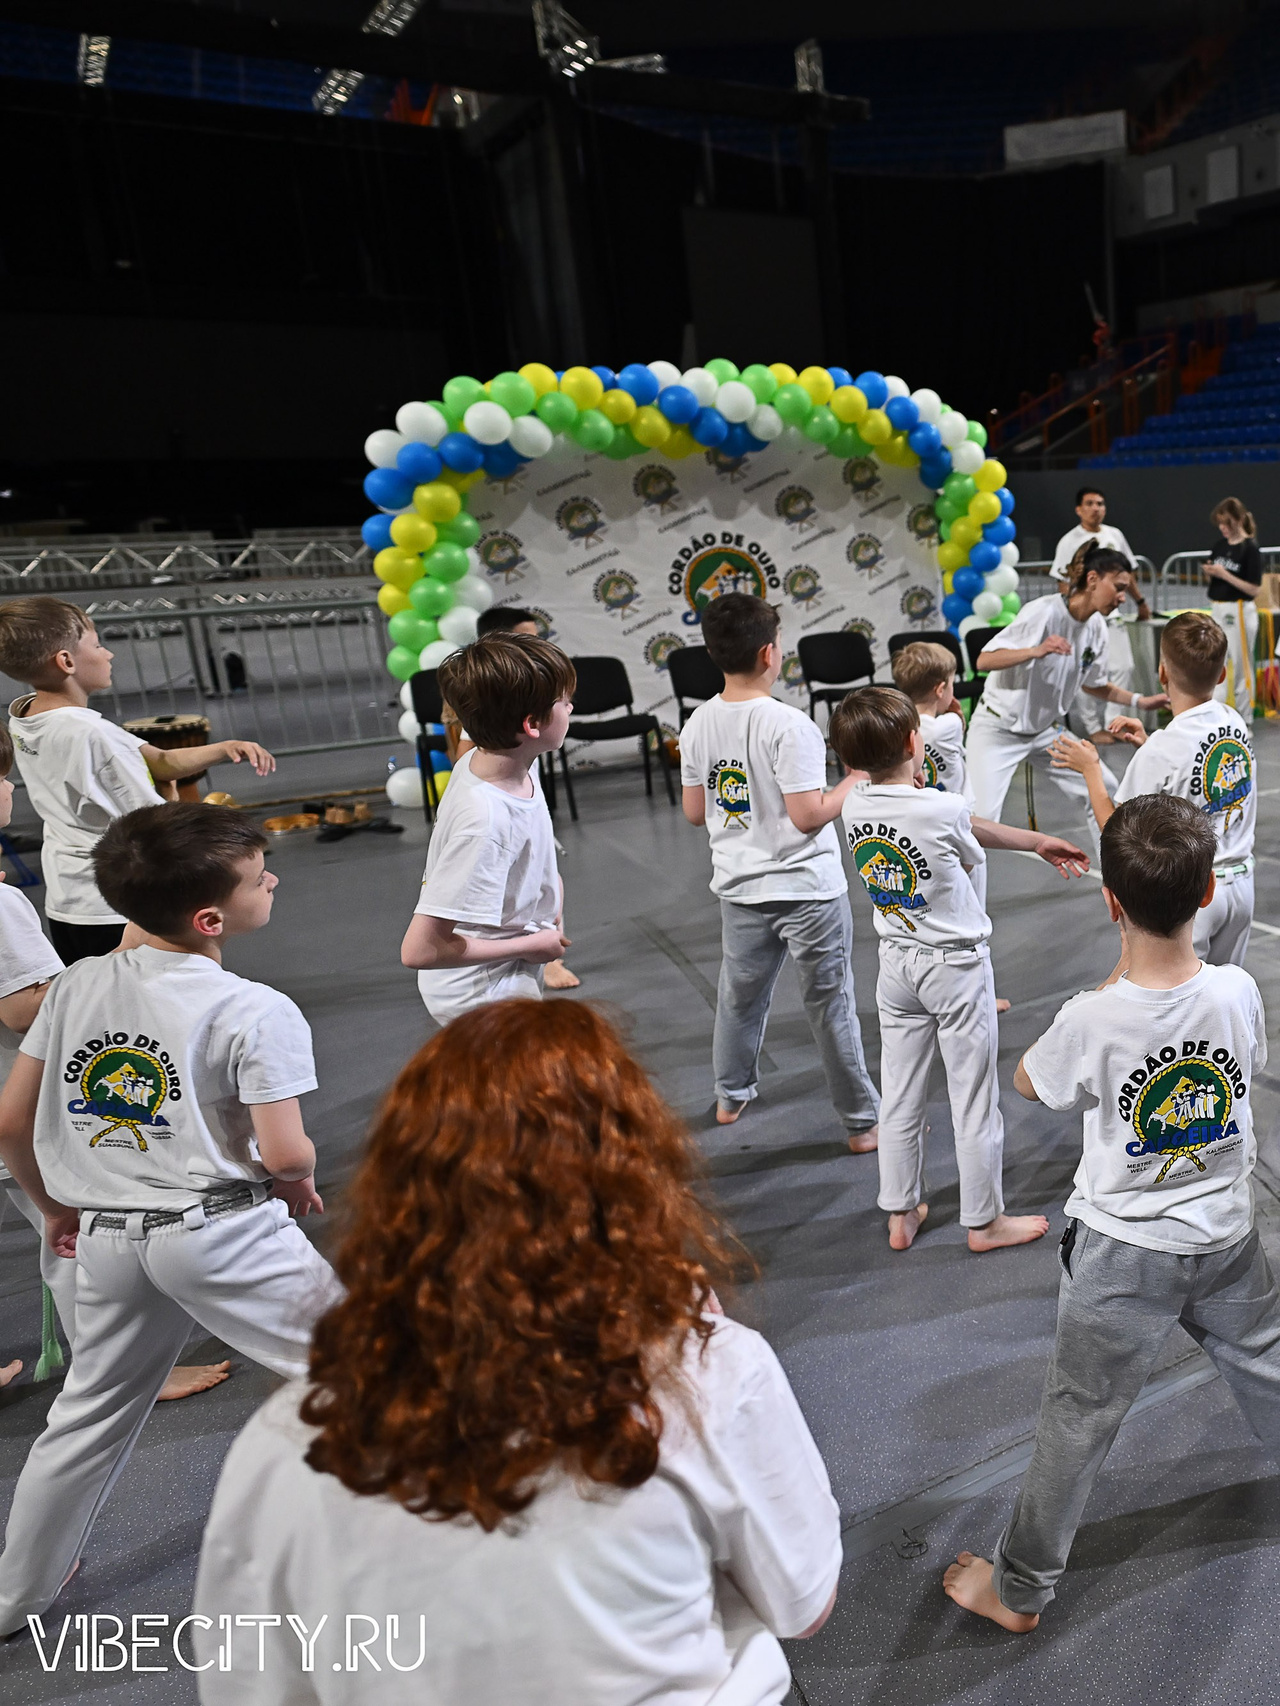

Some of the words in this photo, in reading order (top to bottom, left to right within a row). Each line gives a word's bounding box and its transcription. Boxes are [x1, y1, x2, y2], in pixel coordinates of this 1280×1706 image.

[669, 533, 716, 595] CORDÃO
[721, 531, 744, 547] DE
[748, 542, 780, 589] OURO
[925, 743, 946, 772] OURO
[1190, 732, 1216, 796] CORDÃO
[1218, 726, 1231, 738] DE
[877, 823, 897, 841] DE
[898, 836, 932, 880] OURO
[64, 1031, 129, 1083] CORDÃO
[133, 1034, 160, 1054] DE
[160, 1051, 182, 1101] OURO
[1118, 1046, 1177, 1122] CORDÃO
[1182, 1040, 1210, 1057] DE
[1212, 1048, 1246, 1100] OURO
[1125, 1120, 1240, 1157] CAPOEIRA
[1126, 1160, 1153, 1169] MESTRE
